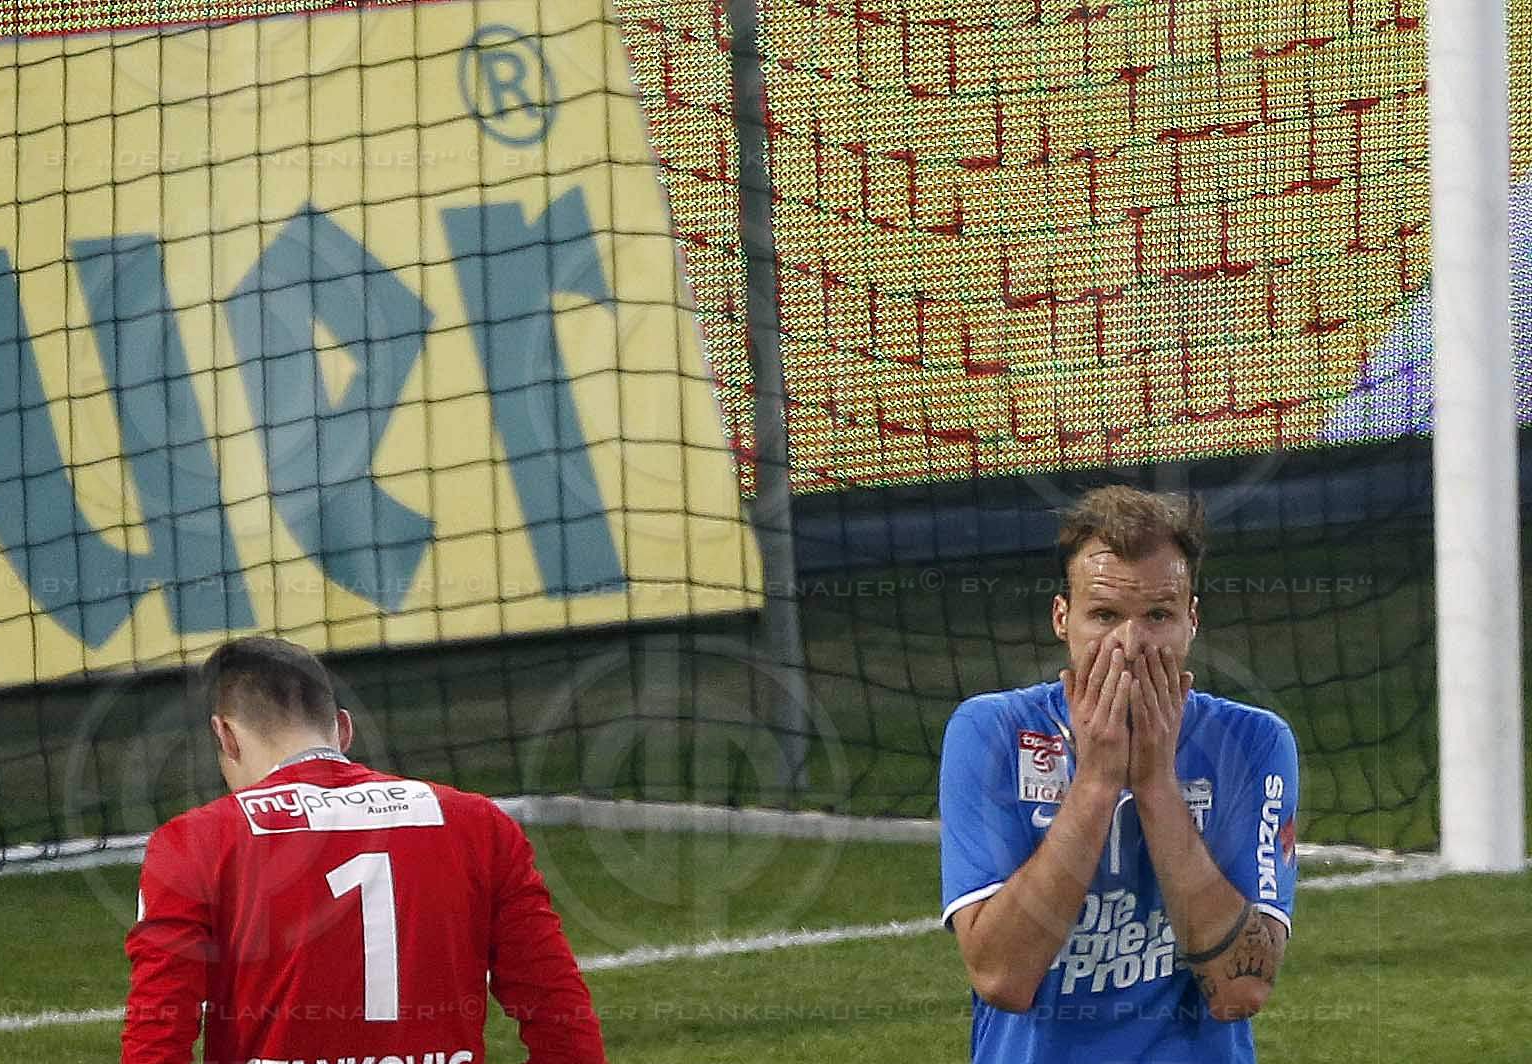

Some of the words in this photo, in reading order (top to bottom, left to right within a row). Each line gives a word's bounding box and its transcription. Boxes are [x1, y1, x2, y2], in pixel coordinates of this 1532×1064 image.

[367, 802, 409, 815] Austria
[1256, 775, 1284, 900] SUZUKI
[325, 851, 399, 1022] 1
[1060, 936, 1176, 995] Profi
